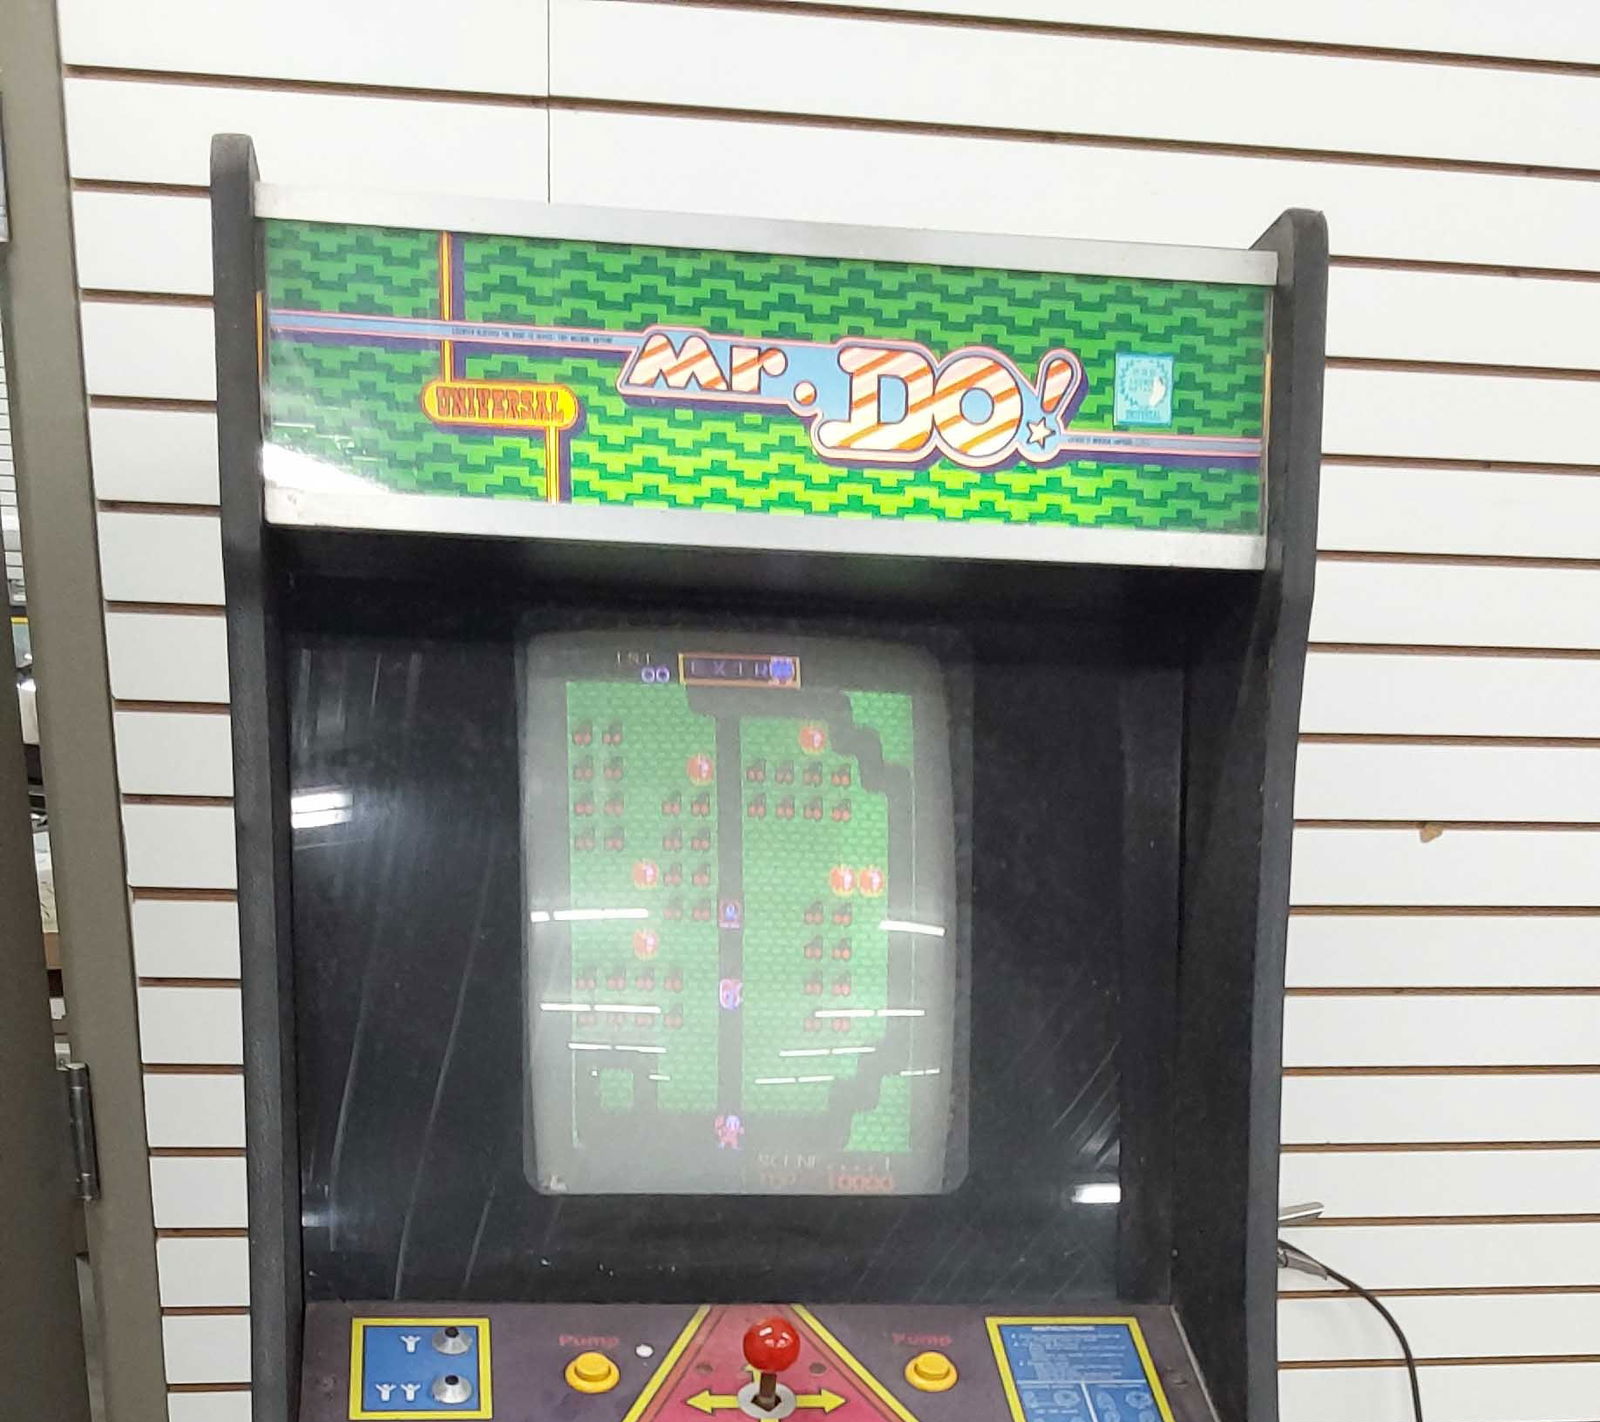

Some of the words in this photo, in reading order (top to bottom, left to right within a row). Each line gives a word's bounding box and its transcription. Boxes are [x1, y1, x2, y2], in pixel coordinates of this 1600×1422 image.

[435, 386, 565, 423] UNIVERSAL
[627, 333, 818, 406] Mr.
[817, 345, 1074, 458] DO!
[558, 1333, 621, 1350] Pump
[891, 1332, 953, 1348] Pump
